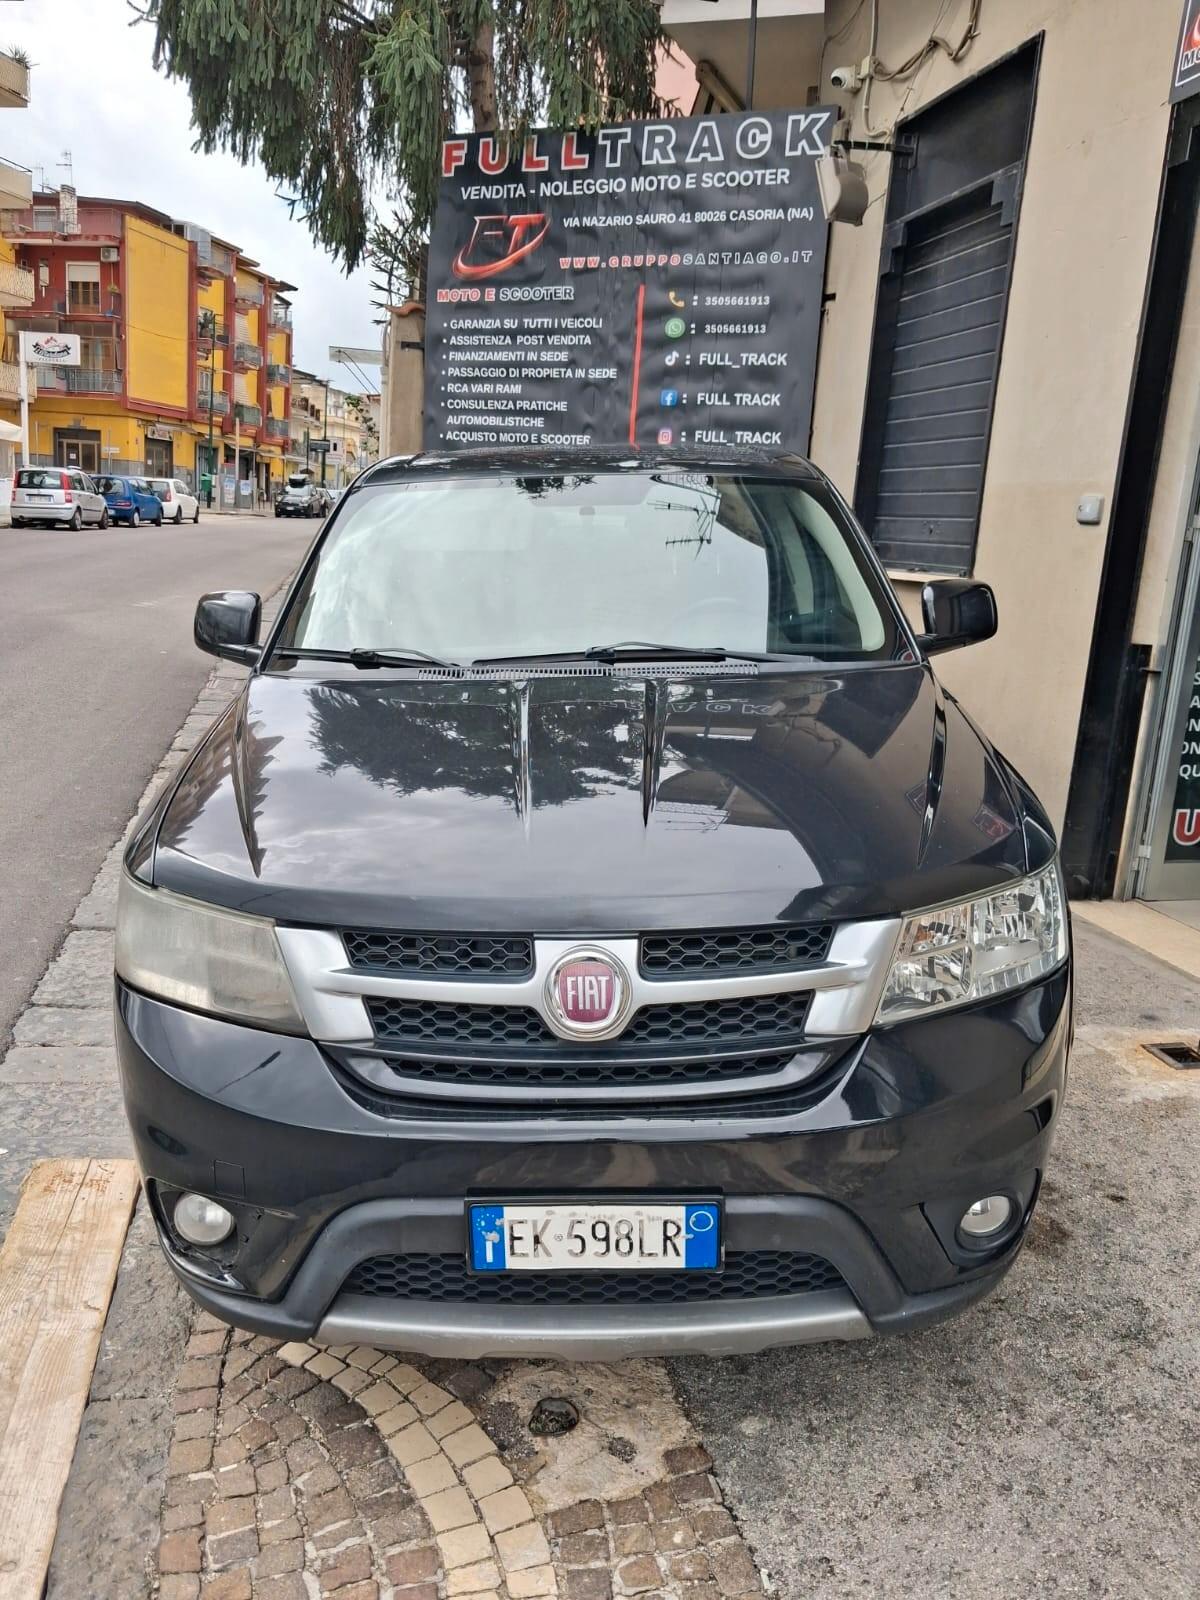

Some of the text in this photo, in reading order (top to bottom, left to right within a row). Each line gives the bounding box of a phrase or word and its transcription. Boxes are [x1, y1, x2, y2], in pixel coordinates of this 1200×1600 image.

[461, 183, 526, 200] VENDITA
[539, 178, 627, 197] NOLEGGIO
[631, 174, 681, 192] MOTO
[685, 173, 697, 189] E
[701, 168, 790, 188] SCOOTER
[563, 207, 814, 228] VIA NAZARIO SAURO 41 80026 CASORIA (NA)
[559, 251, 813, 269] WWW.GRUPPOSANTIAGO.IT
[437, 286, 575, 302] MOTO E SCOOTER
[704, 296, 770, 306] 3505661913
[450, 317, 603, 330] GARANZIA SU TUTTI I VEICOLI
[704, 324, 766, 334] 3505661913
[449, 335, 592, 346] ASSISTENZA POST VENDITA
[449, 351, 569, 362] FINANZIAMENTI IN SEDE
[699, 353, 788, 368] FULL_TRACK
[447, 367, 617, 379] PASSAGGIO DI PROPIETA IN SEDE
[447, 383, 522, 394] RCA VARI RAMI
[447, 399, 567, 411] CONSULENZA PRATICHE
[697, 392, 730, 406] FULL
[734, 393, 781, 406] TRACK
[446, 415, 544, 427] AUTOMOBILISTICHE
[446, 431, 591, 446] ACQUISTO MOTO E SCOOTER
[694, 430, 781, 446] FULL_TRACK
[566, 975, 610, 1010] FIAT
[508, 1219, 553, 1258] EK
[567, 1219, 682, 1258] 598LR
